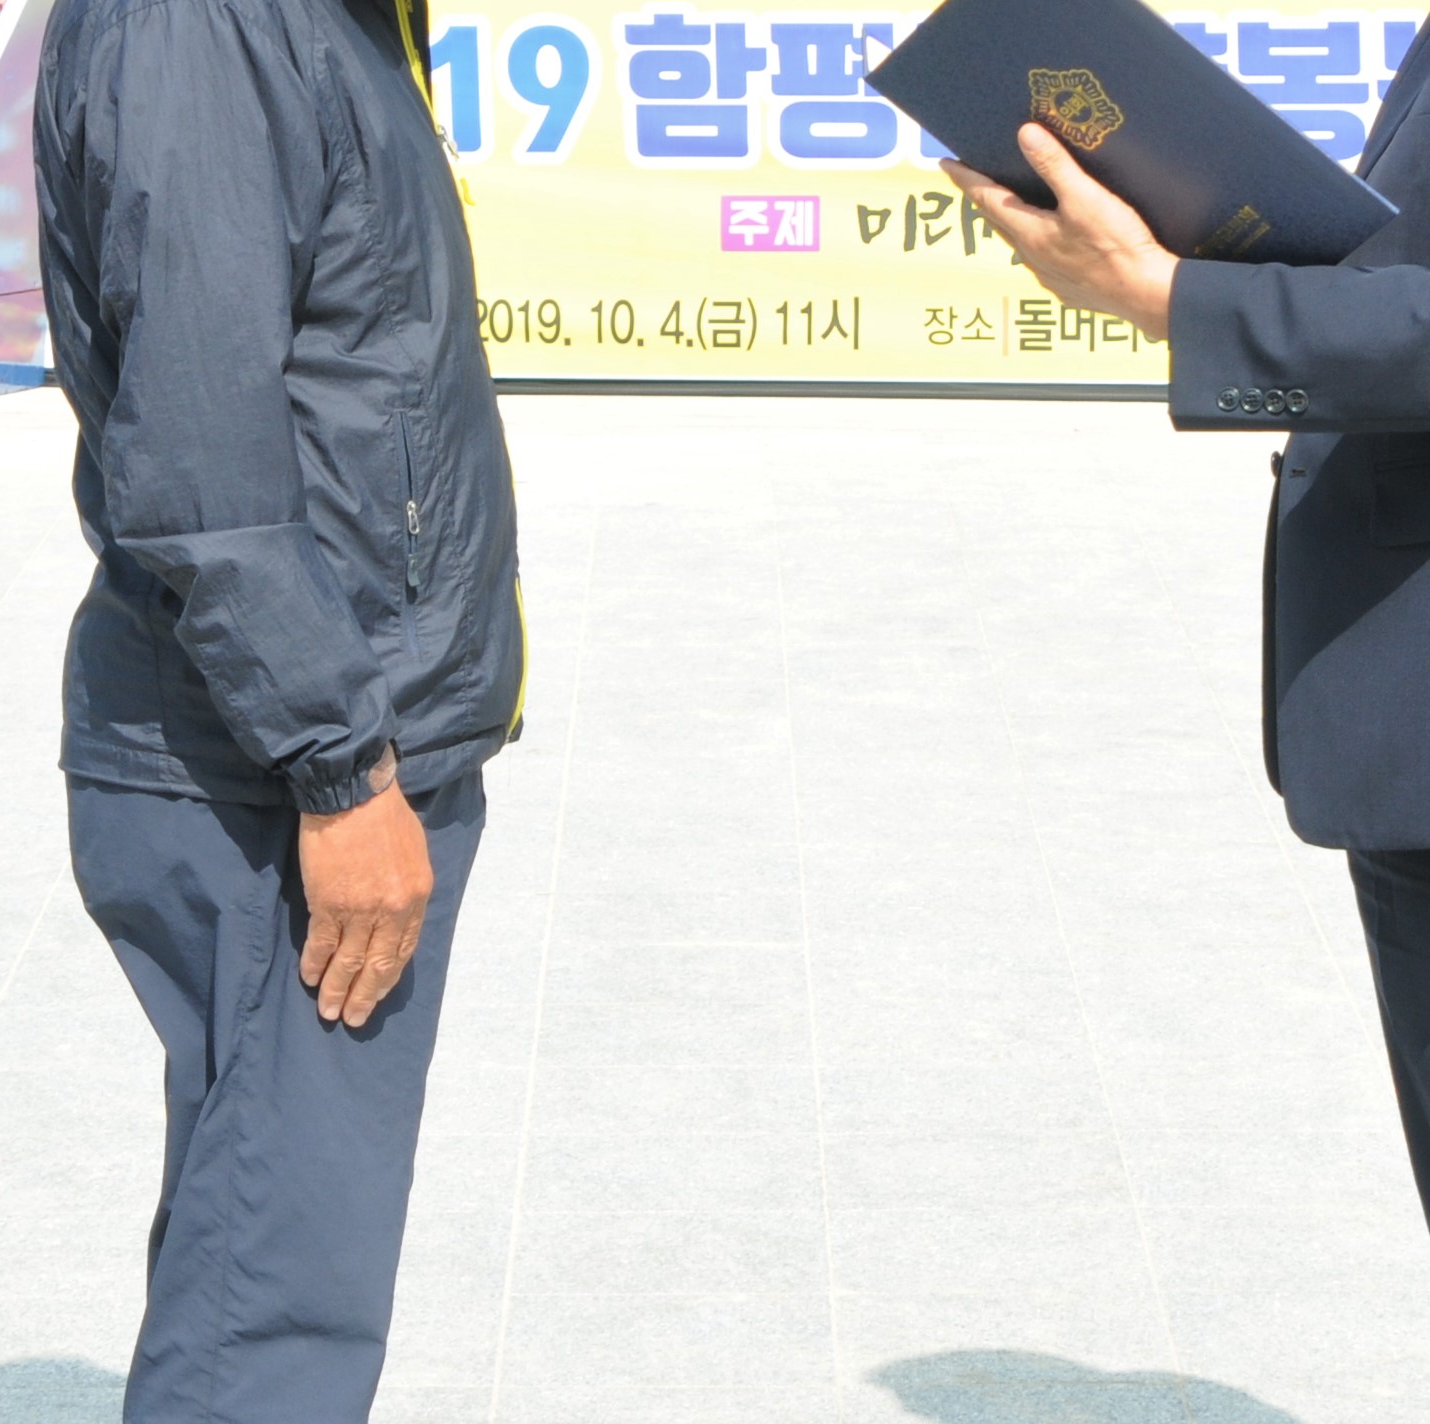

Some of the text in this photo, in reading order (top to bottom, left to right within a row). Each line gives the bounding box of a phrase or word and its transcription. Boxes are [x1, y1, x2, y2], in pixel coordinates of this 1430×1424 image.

[624, 13, 961, 159] 함평
[728, 201, 815, 248] 주제
[857, 191, 1023, 266] 미래
[590, 298, 646, 348] 10.
[660, 296, 759, 351] 4.(금)
[775, 295, 863, 351] 11시
[923, 305, 997, 347] 장소
[1014, 298, 1171, 354] 돌머리
